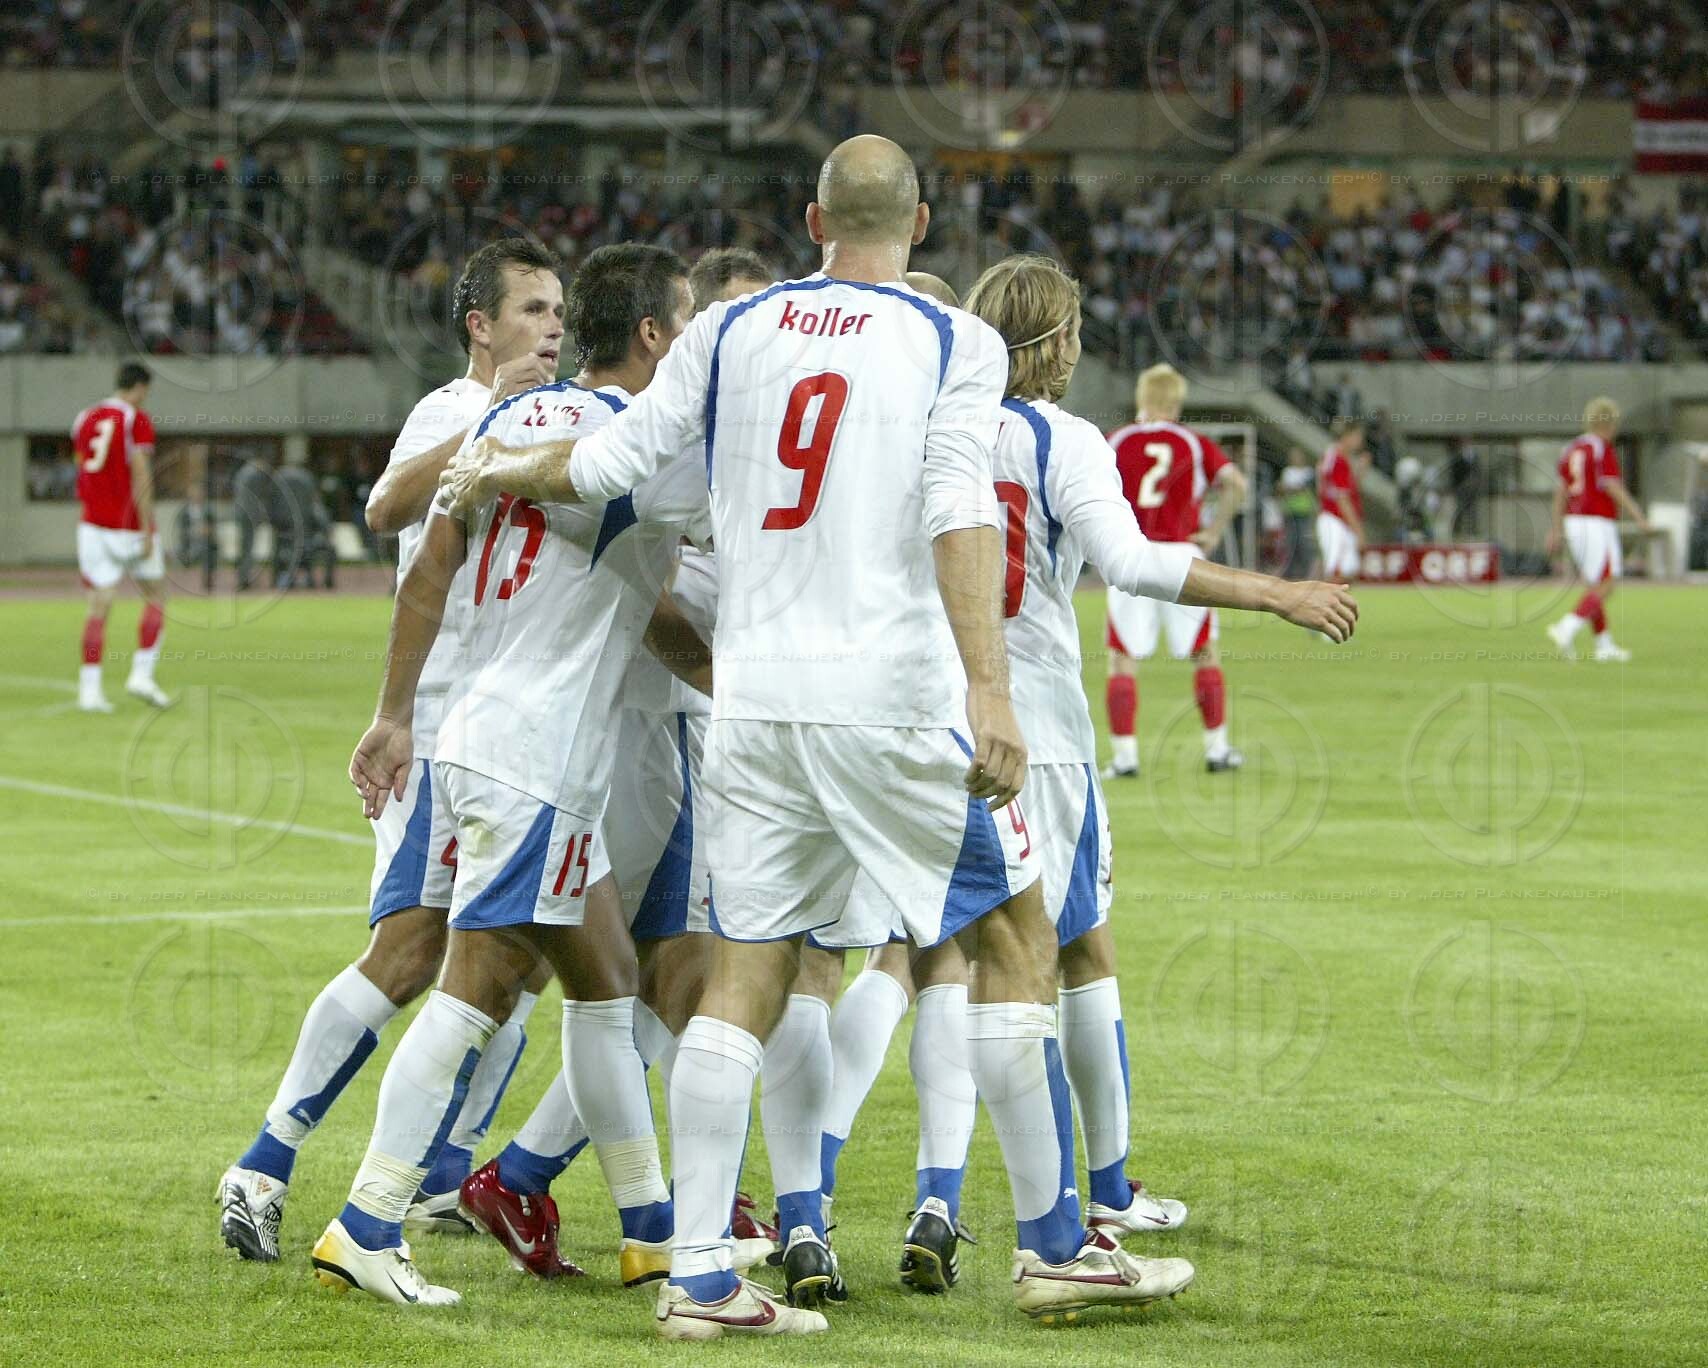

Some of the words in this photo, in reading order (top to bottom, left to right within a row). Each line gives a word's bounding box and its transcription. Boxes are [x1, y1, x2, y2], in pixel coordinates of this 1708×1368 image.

[778, 301, 873, 337] koller
[83, 418, 115, 473] 3
[761, 371, 850, 530] 9
[1137, 442, 1172, 509] 2
[1007, 797, 1031, 862] 9
[552, 833, 593, 897] 15
